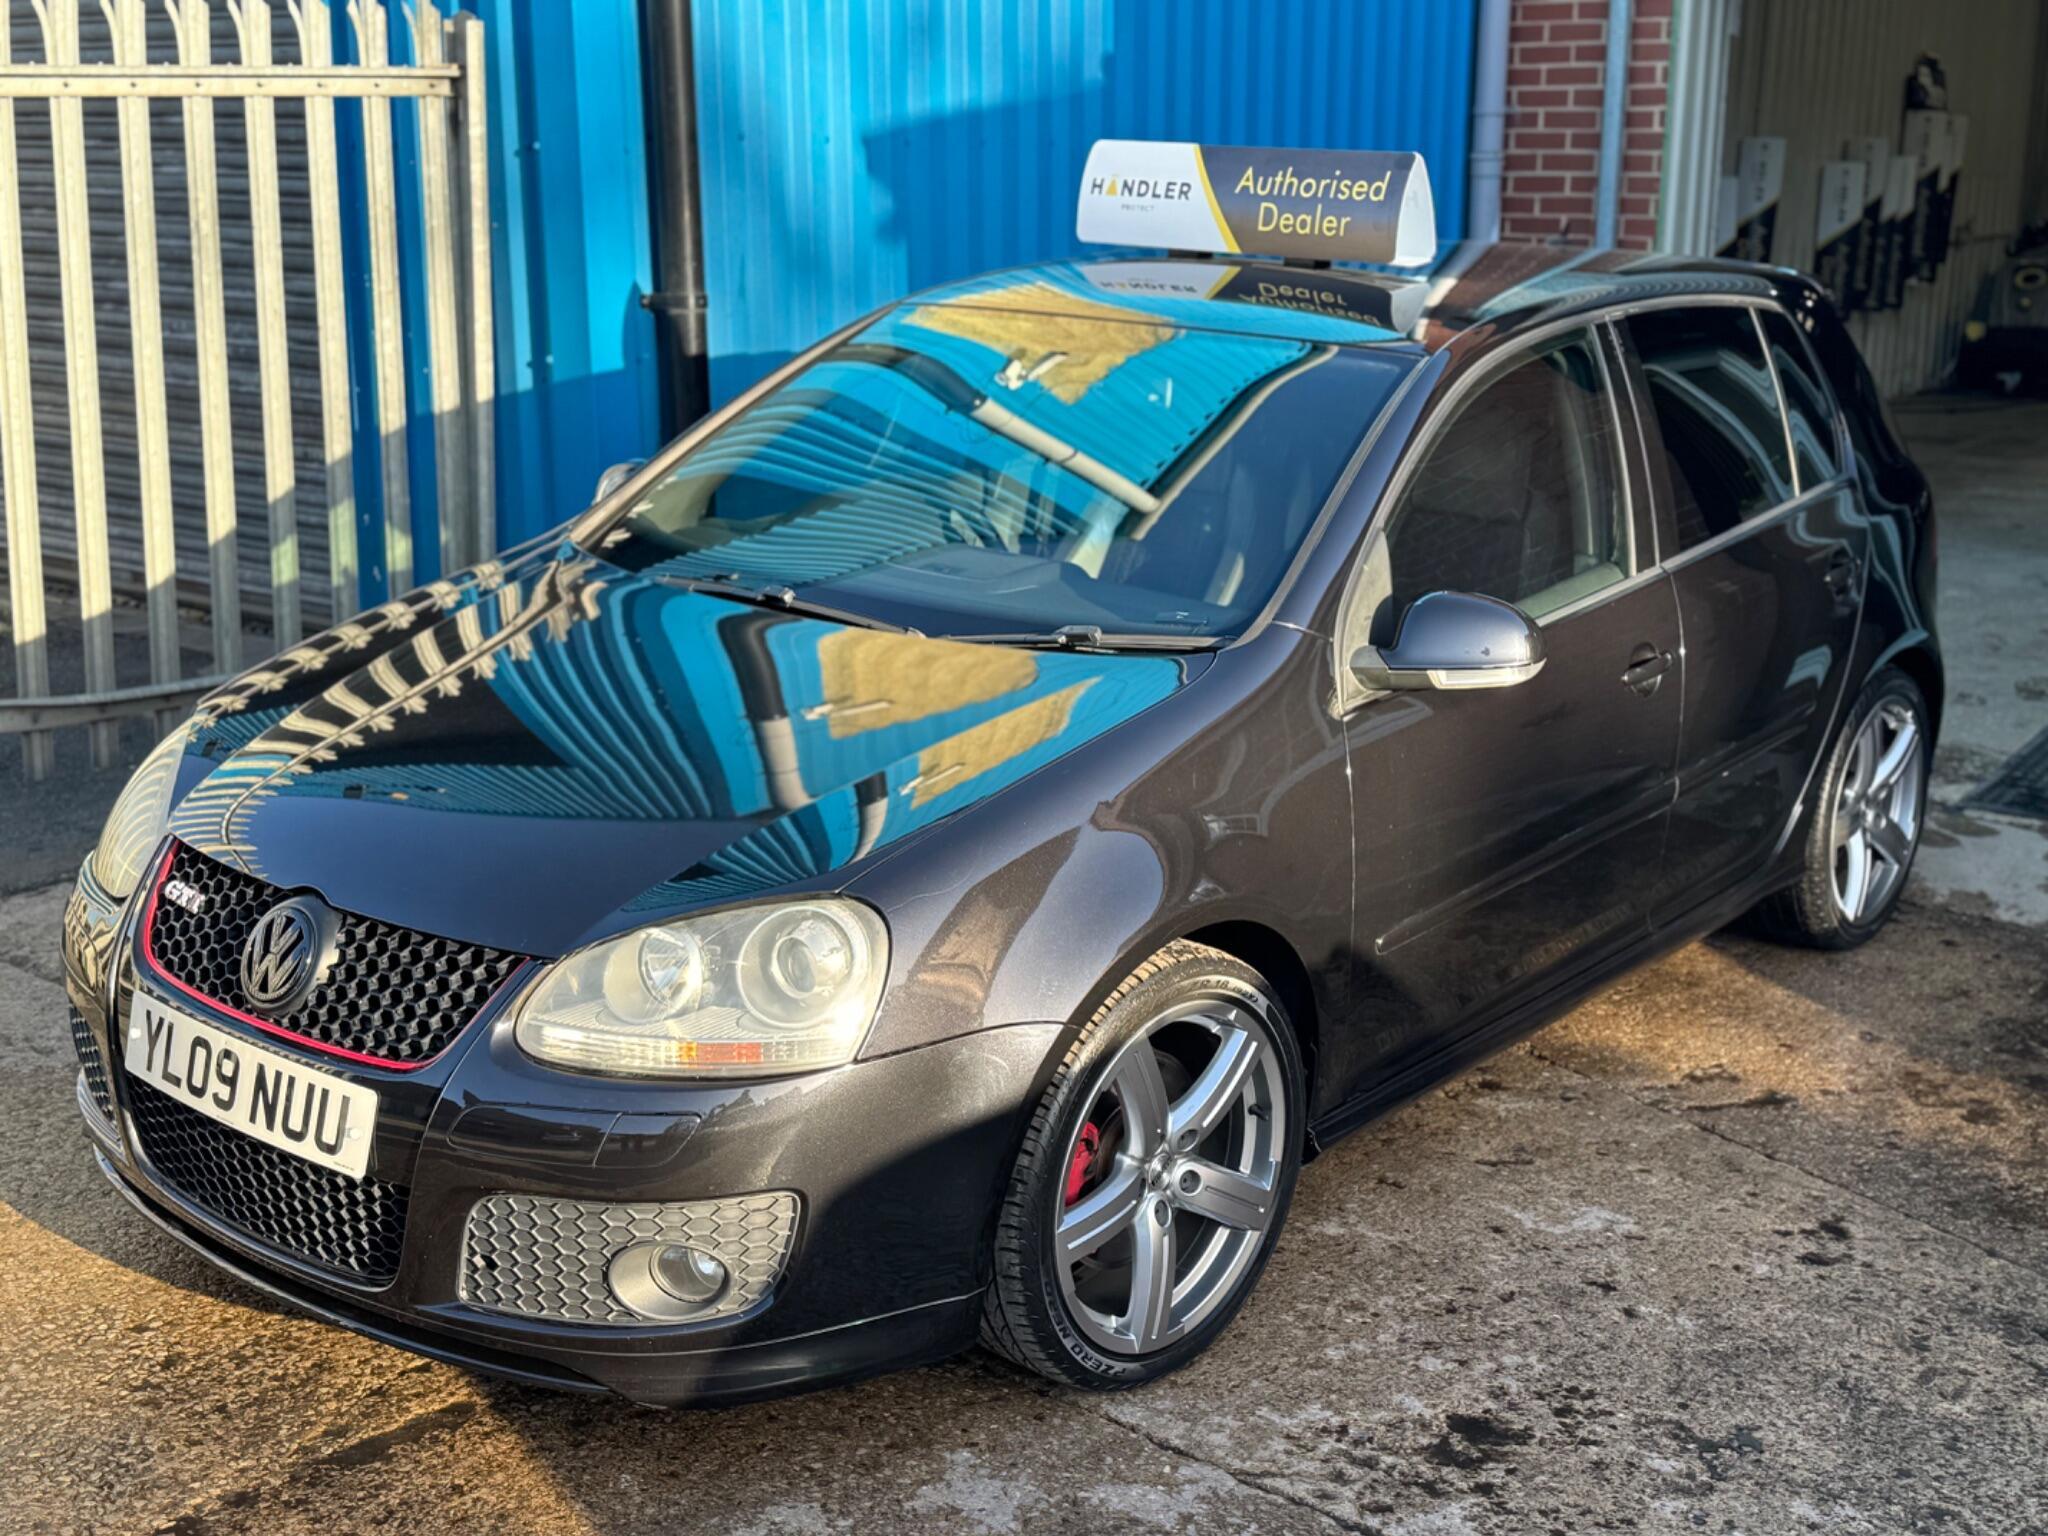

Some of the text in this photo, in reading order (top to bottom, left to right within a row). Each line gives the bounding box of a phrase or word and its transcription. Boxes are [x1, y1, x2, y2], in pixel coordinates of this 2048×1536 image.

[1234, 167, 1391, 202] Authorised
[1257, 202, 1351, 237] Dealer
[164, 880, 206, 914] GTI
[145, 1010, 350, 1156] YL09 NUU
